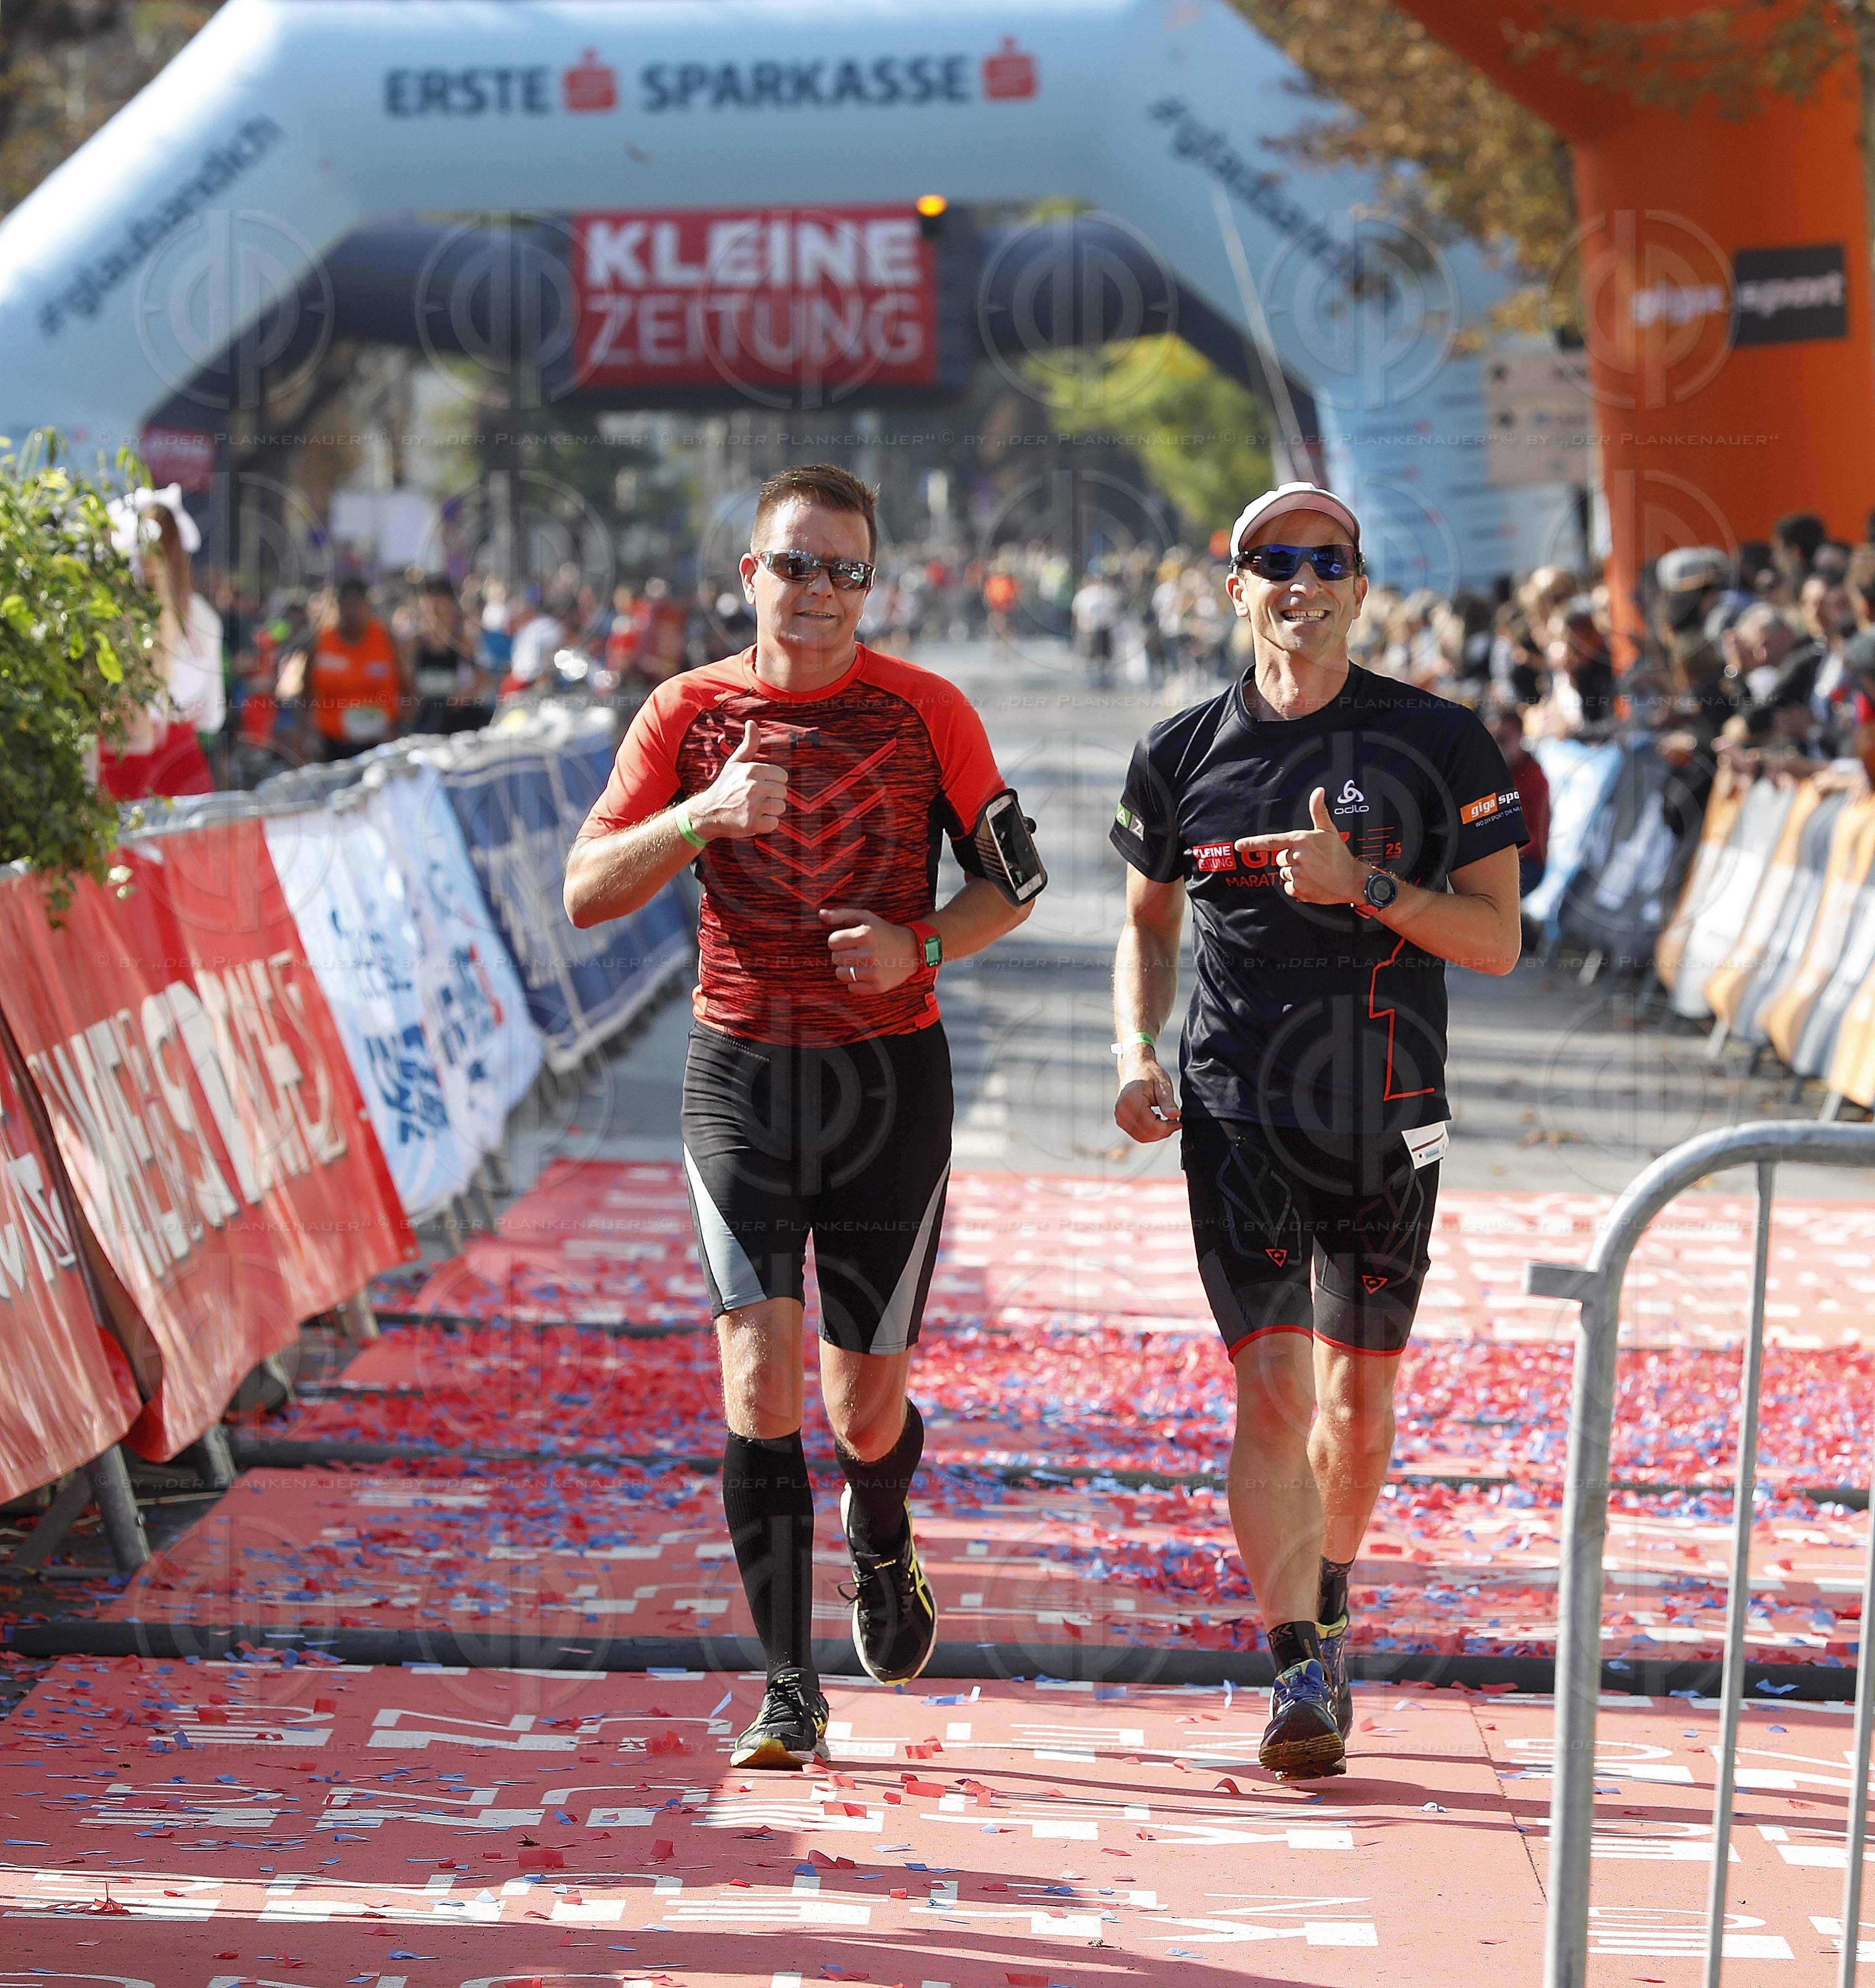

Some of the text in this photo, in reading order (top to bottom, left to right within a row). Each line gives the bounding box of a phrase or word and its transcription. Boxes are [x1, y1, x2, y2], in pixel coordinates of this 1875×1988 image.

[384, 53, 972, 119] ERSTE SPARKASSE
[585, 218, 921, 288] KLEINE
[589, 294, 923, 366] ZEITUNG
[1334, 804, 1369, 814] odlo
[1471, 799, 1496, 817] giga
[1386, 842, 1402, 855] 25
